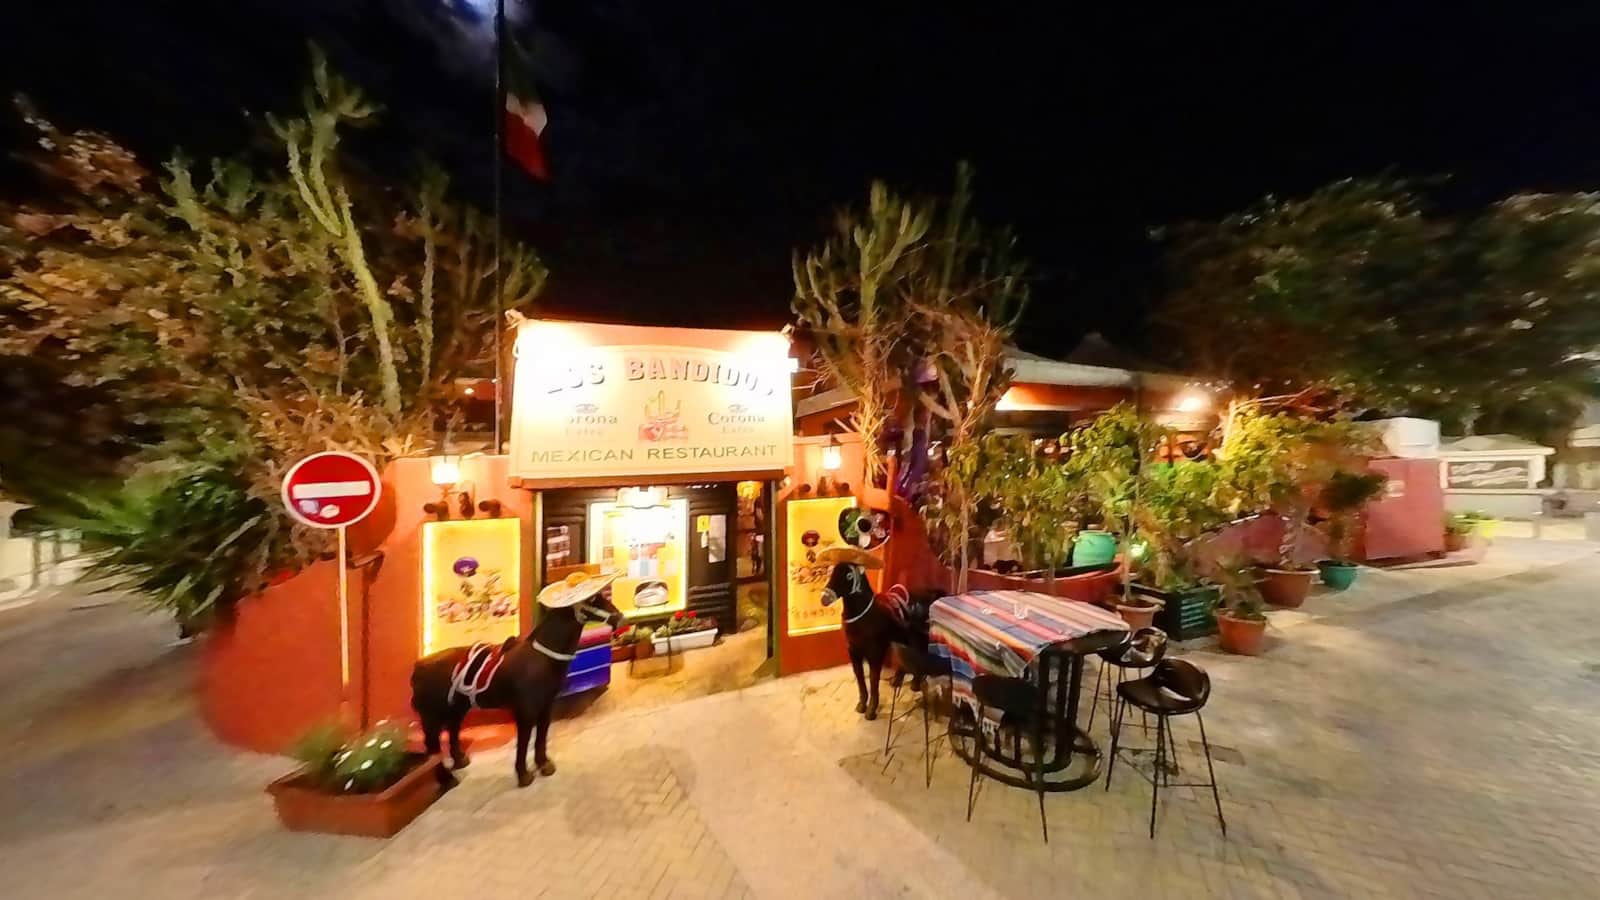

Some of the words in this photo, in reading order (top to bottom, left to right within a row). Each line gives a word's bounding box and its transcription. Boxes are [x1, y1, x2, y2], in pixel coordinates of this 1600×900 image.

[545, 359, 606, 395] OS
[624, 357, 773, 396] BANDIDO
[707, 411, 765, 426] Corona
[531, 448, 634, 463] MEXICAN
[647, 444, 777, 460] RESTAURANT
